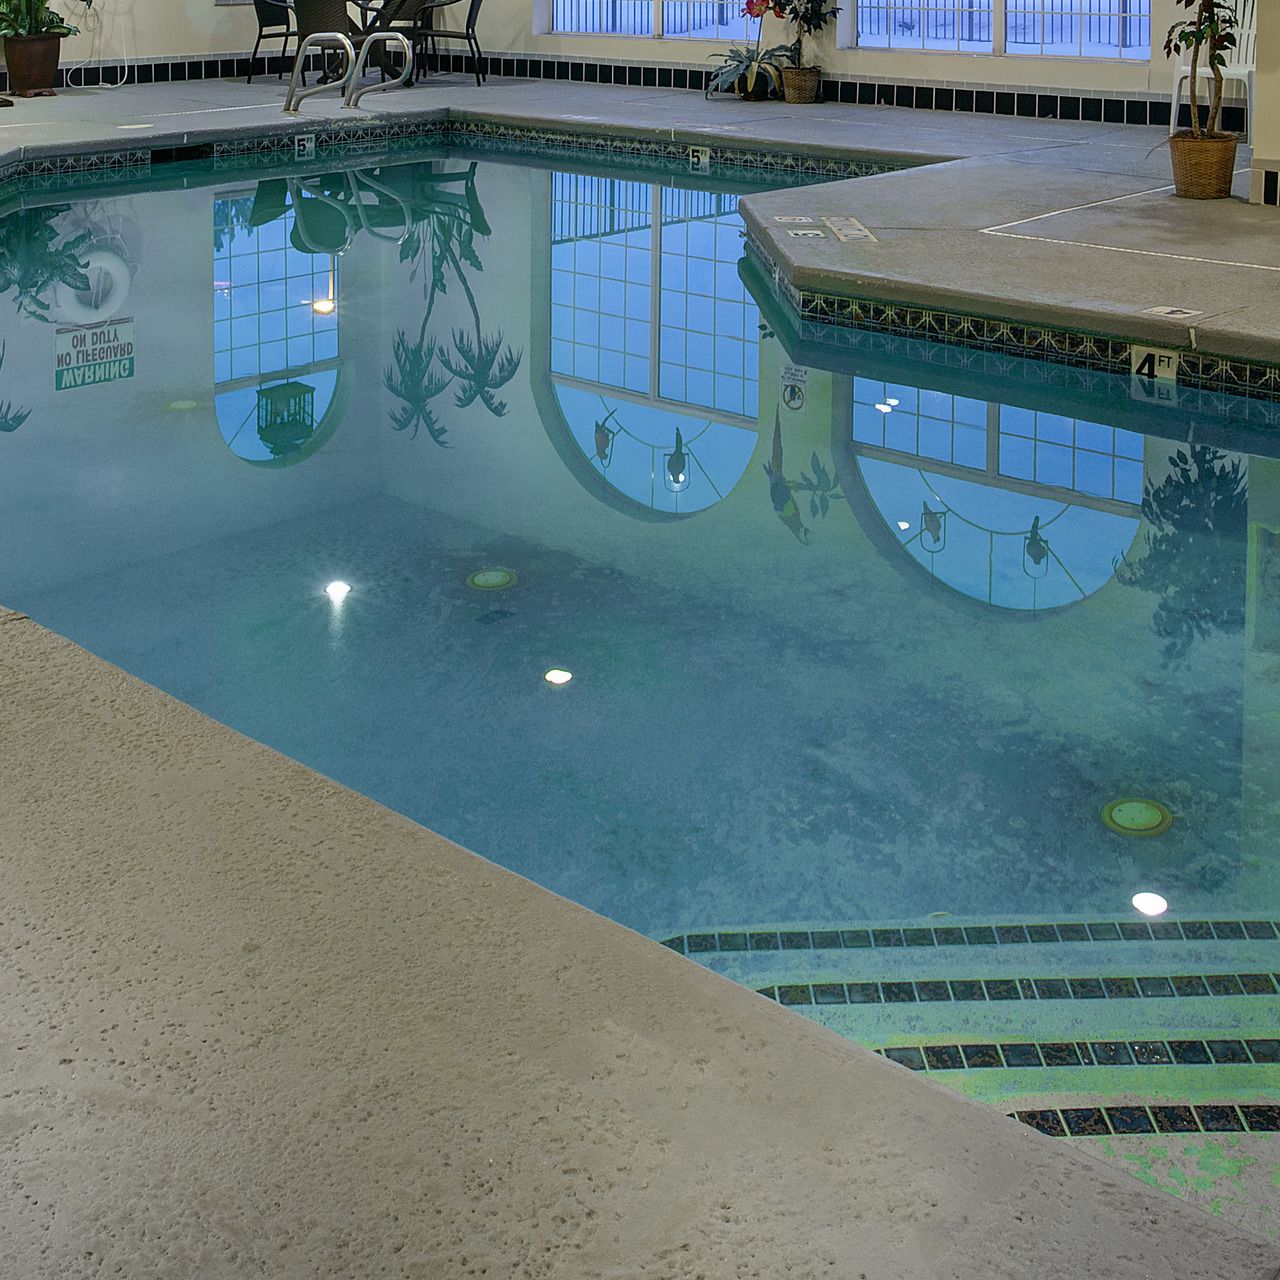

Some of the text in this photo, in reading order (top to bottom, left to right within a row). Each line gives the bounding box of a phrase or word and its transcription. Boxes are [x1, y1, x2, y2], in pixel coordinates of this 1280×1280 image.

[297, 138, 306, 152] 5
[691, 148, 701, 166] 5
[1136, 352, 1173, 379] 4 FT
